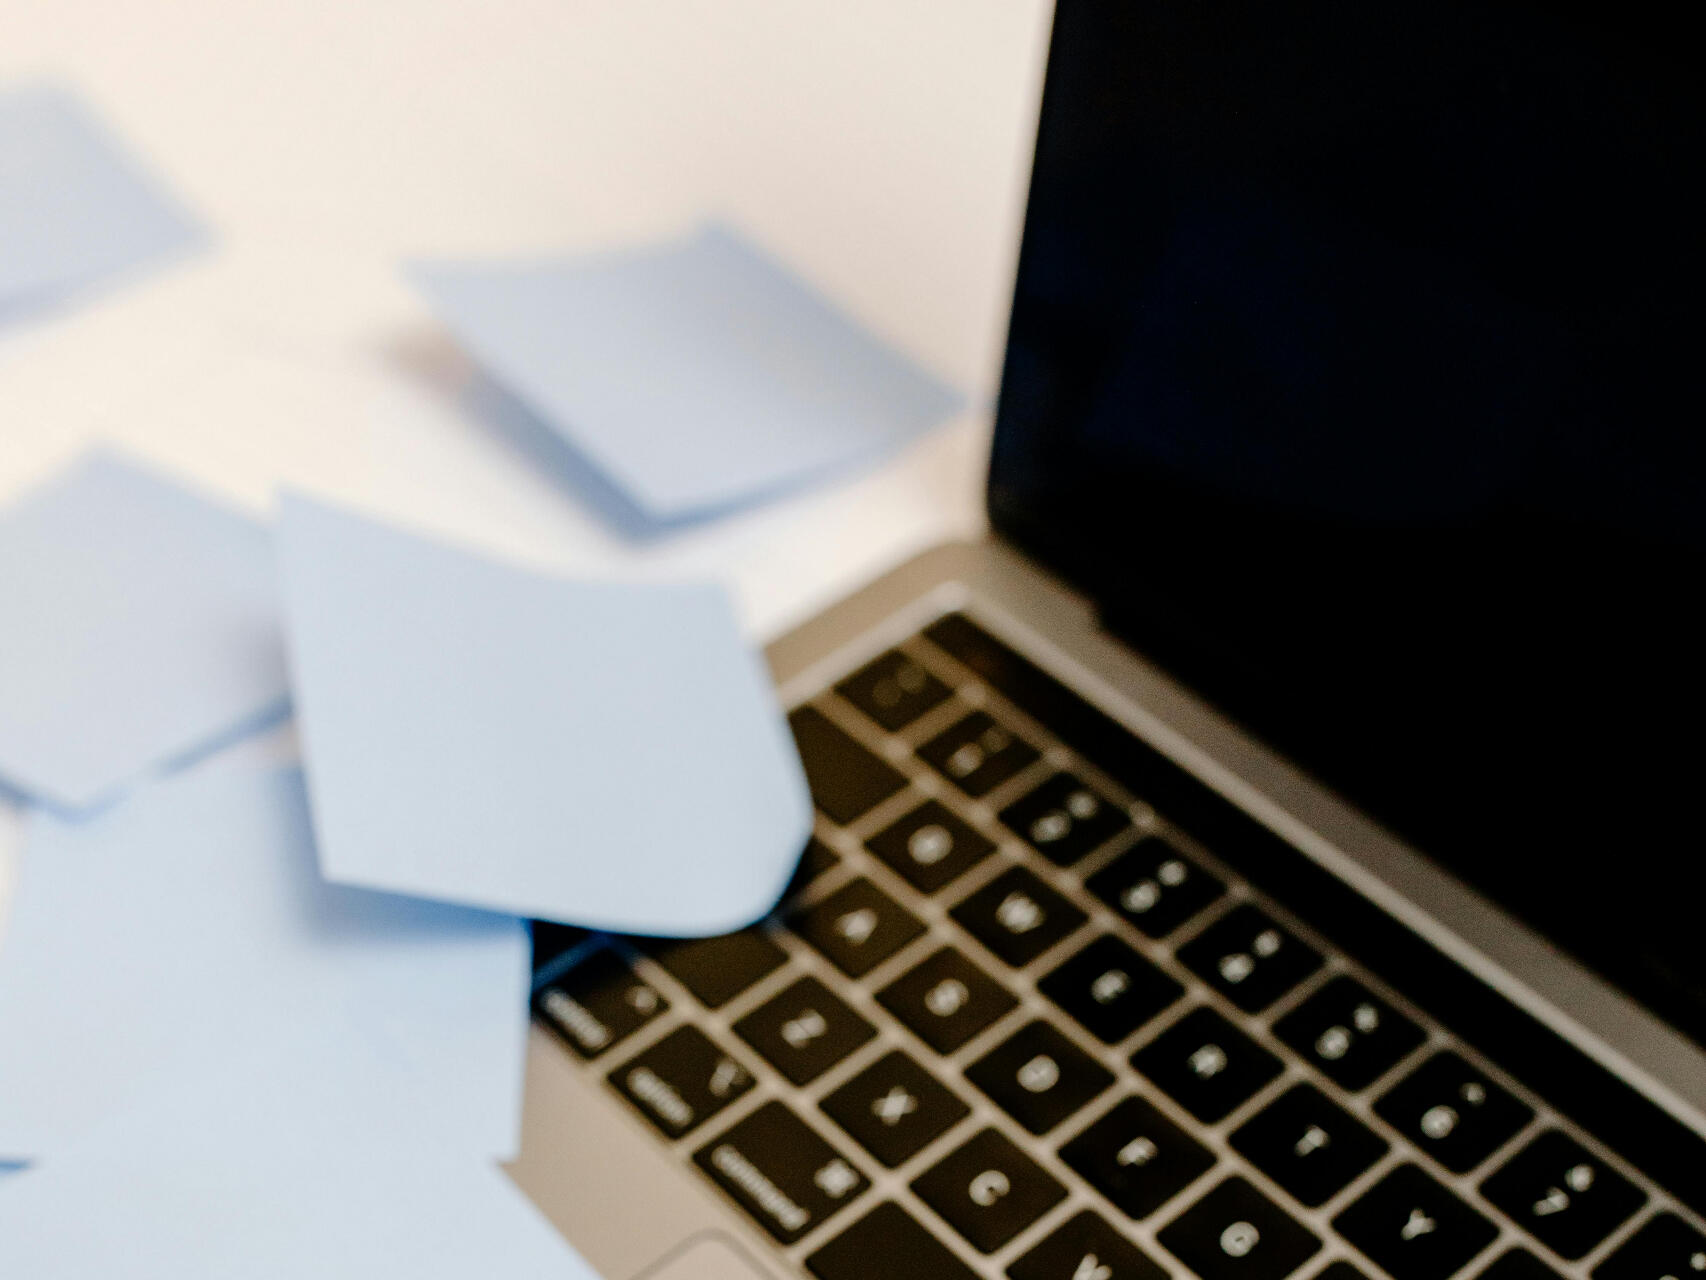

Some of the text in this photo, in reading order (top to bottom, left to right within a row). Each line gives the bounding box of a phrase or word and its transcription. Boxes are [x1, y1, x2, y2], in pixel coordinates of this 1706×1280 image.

[873, 1087, 915, 1124] X
[968, 1170, 1010, 1206] C
[1220, 1221, 1260, 1257] G
[1402, 1210, 1433, 1239] Y
